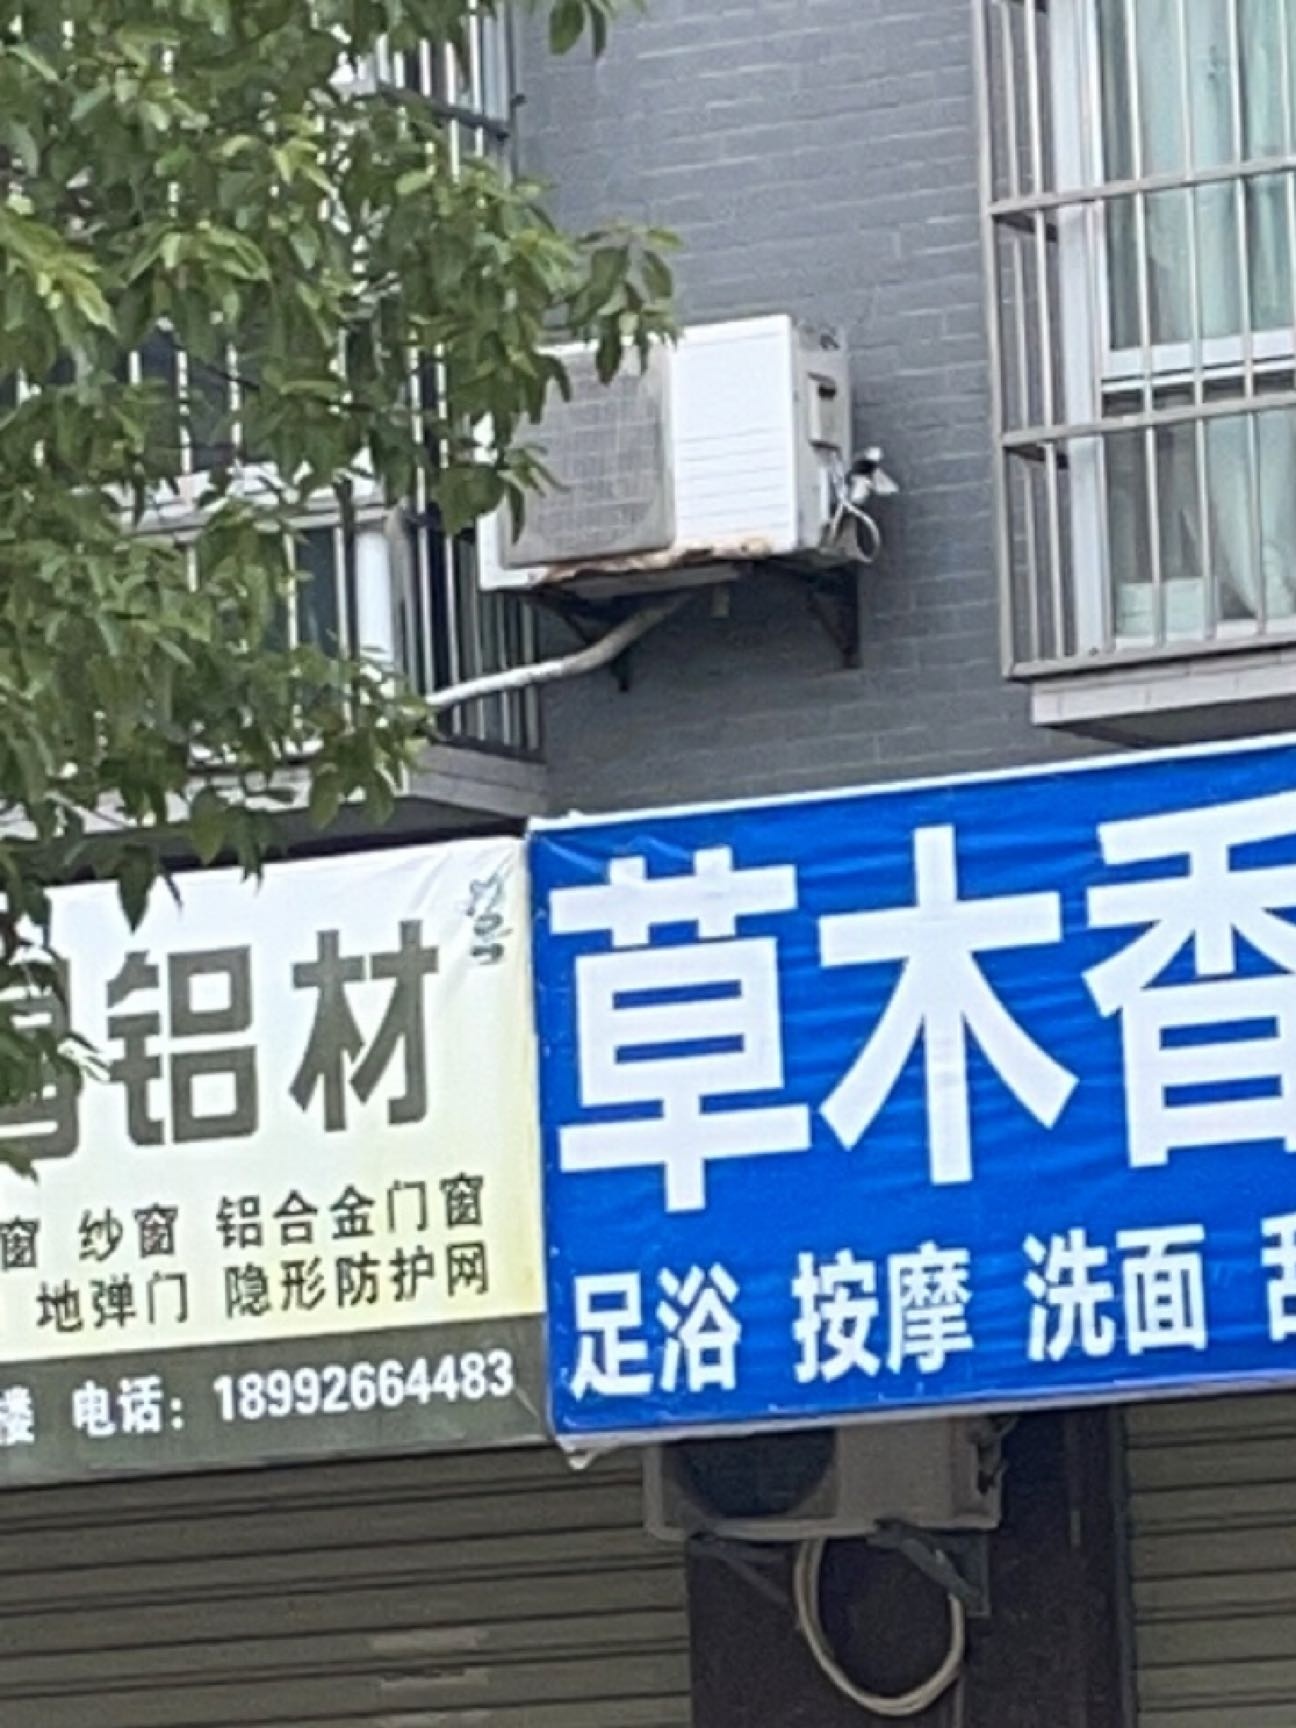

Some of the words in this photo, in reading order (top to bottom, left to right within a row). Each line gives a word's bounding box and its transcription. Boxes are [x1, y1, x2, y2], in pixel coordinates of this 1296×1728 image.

[0, 918, 438, 1165] 铝材
[78, 1203, 179, 1262] 纱窗
[215, 1172, 486, 1250] 铝合金门窗
[36, 1270, 188, 1333] 地弹门
[223, 1240, 489, 1319] 隐形防护网
[569, 1263, 742, 1398] 足浴
[792, 1241, 974, 1382] 按摩
[1023, 1224, 1207, 1361] 洗面
[213, 1348, 514, 1421] 18992664483
